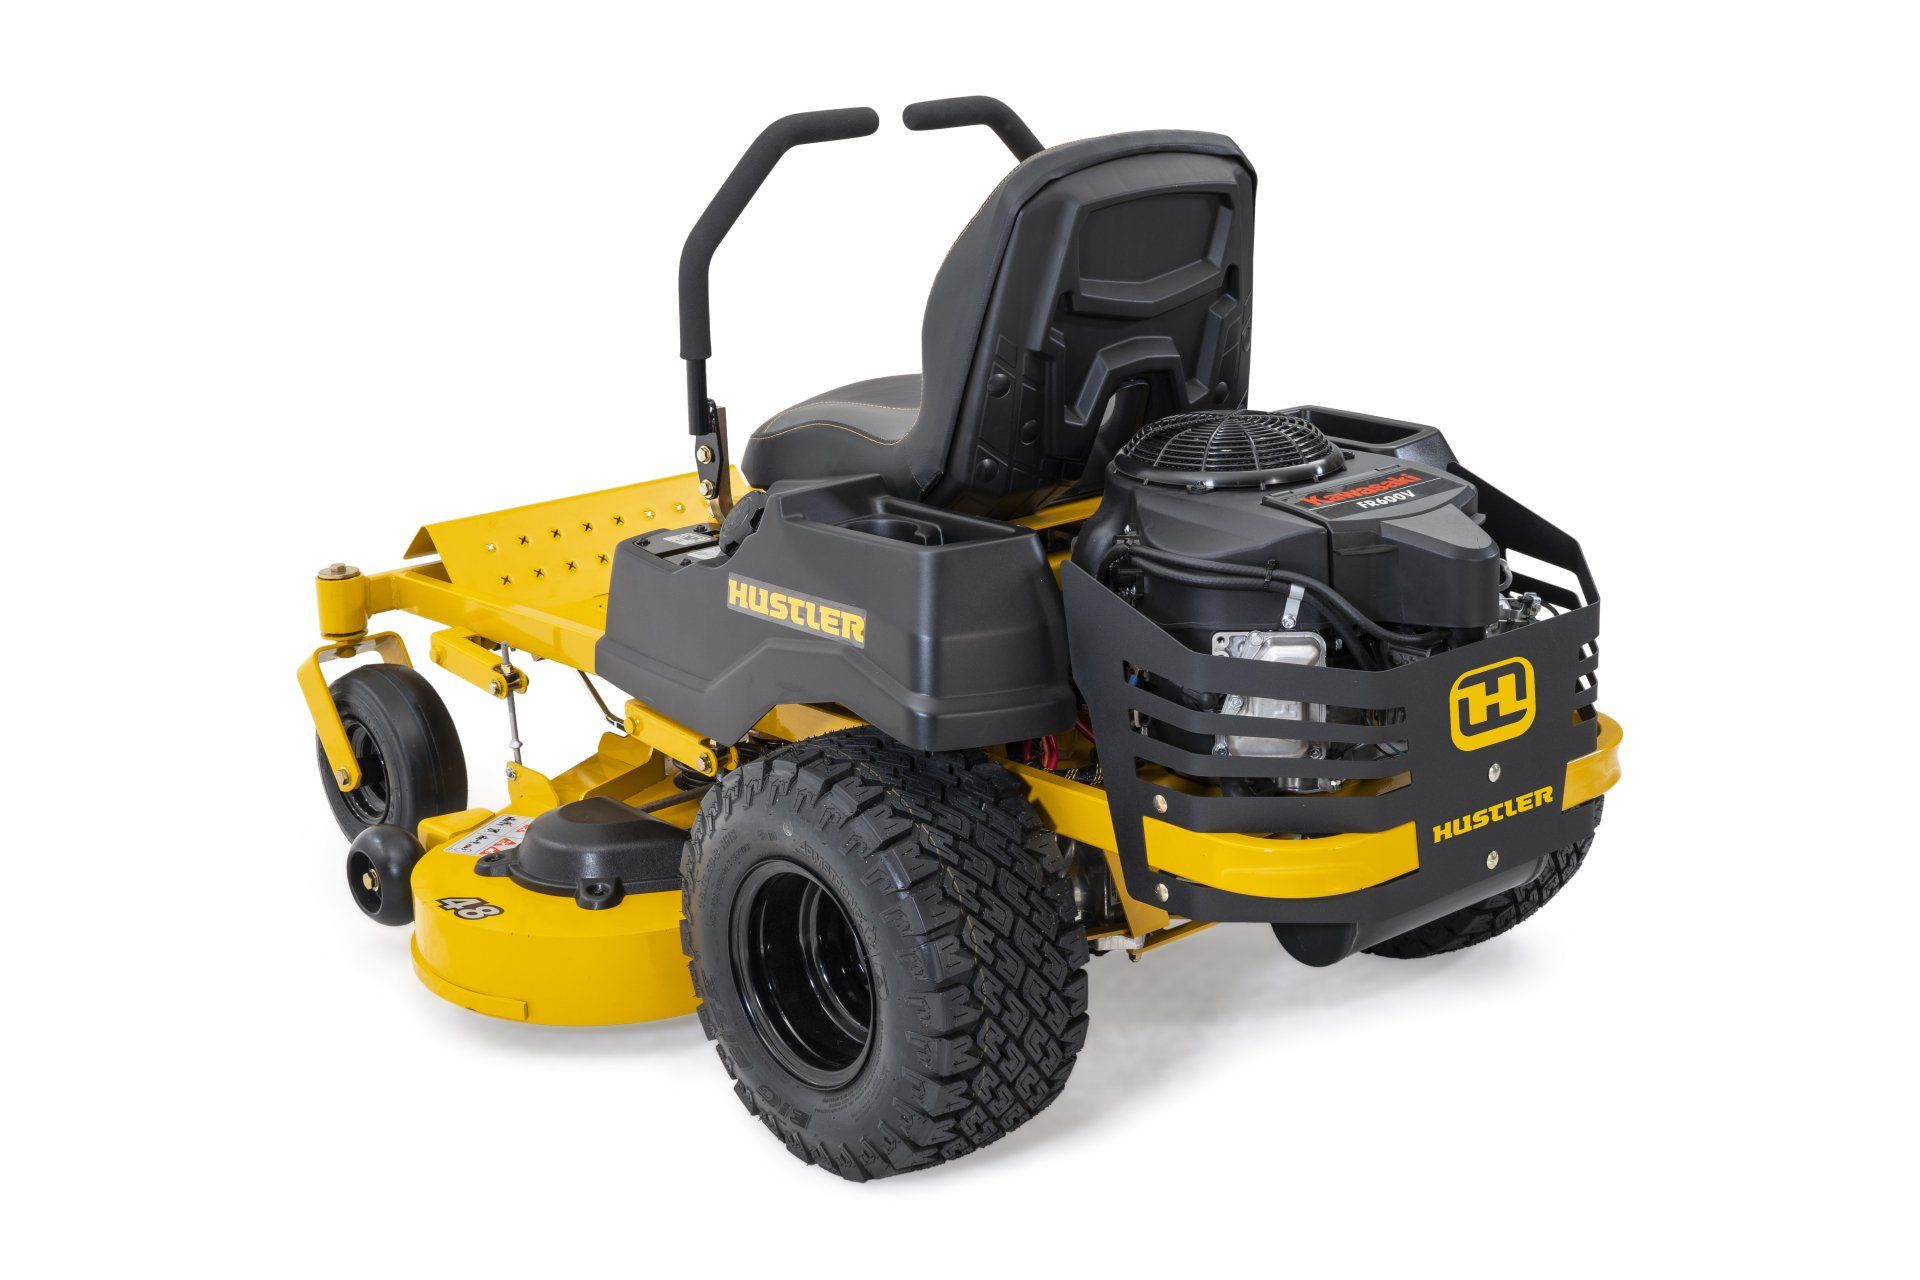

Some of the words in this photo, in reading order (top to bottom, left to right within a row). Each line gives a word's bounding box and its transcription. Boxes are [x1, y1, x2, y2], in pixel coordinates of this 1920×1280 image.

[1302, 473, 1422, 506] Kawasaki
[1356, 489, 1416, 509] FR600V
[728, 579, 865, 643] HUSTLER
[1433, 785, 1554, 843] HUSTLER
[436, 897, 504, 920] 48
